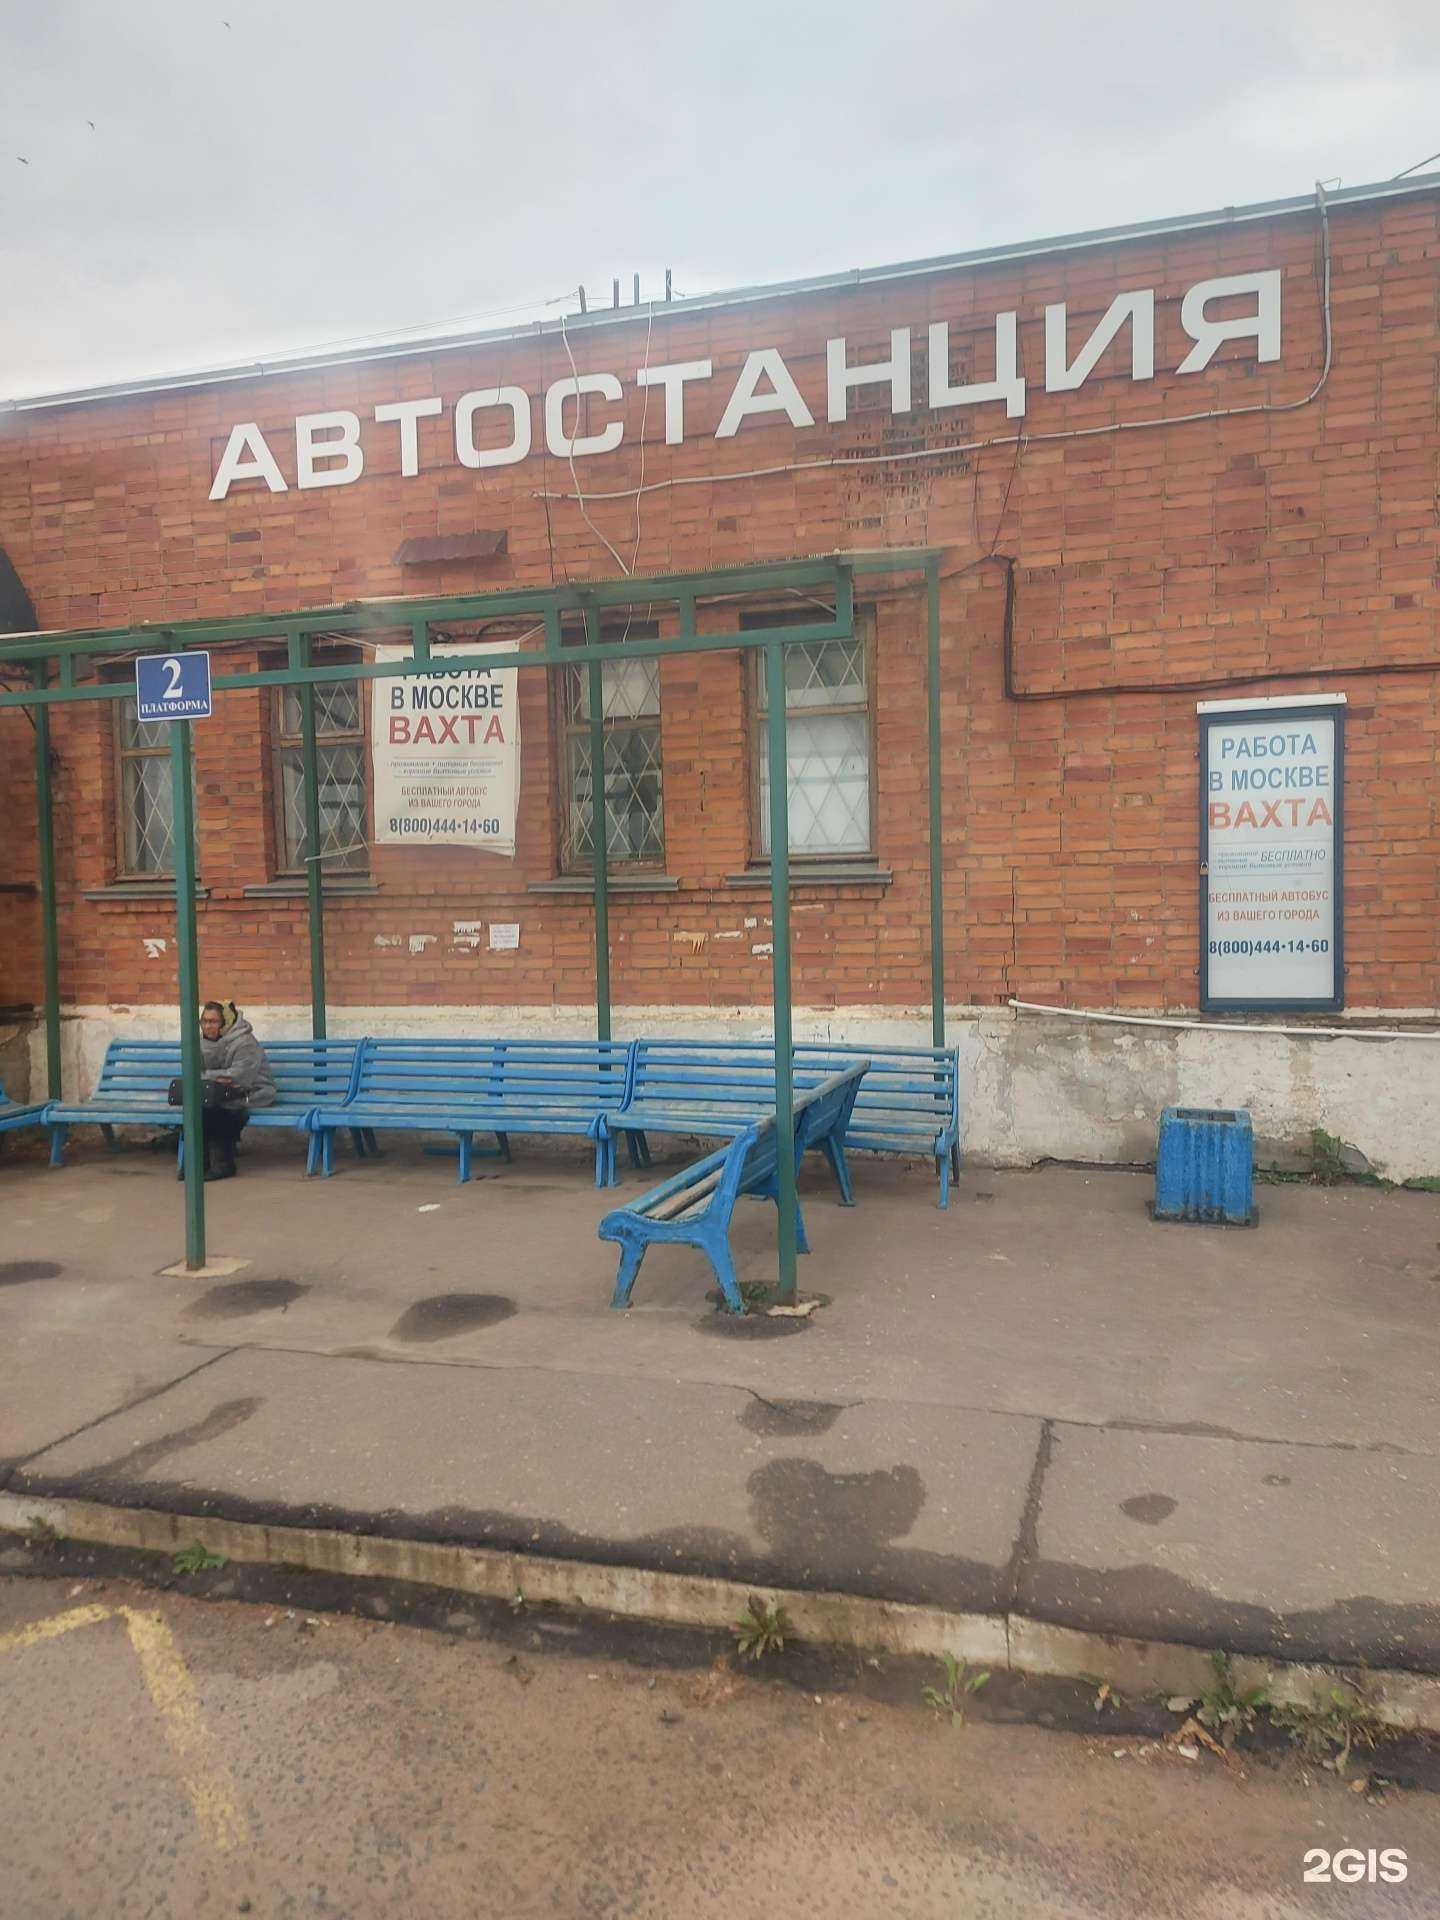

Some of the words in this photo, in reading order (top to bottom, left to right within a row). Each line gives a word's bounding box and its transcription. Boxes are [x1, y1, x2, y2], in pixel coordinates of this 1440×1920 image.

[208, 269, 1282, 500] АВТОСТАНЦИЯ
[161, 658, 184, 699] 2
[141, 699, 208, 714] ПЛАТФОРМА
[390, 686, 405, 710] В
[412, 684, 504, 710] МОСКВЕ
[389, 715, 505, 744] ВАХТА
[1220, 733, 1318, 759] РАБОТА
[401, 784, 455, 796] БЕСПЛАТНЫЙ
[456, 784, 488, 796] АВТОБУС
[1209, 771, 1224, 792] В
[1231, 765, 1330, 791] МОСКВЕ
[408, 798, 419, 808] ИЗ
[421, 798, 451, 808] ВАШЕГО
[453, 798, 481, 808] ГОРОДА
[1208, 798, 1333, 831] ВАХТА
[1260, 848, 1326, 863] БЕСПЛАТНО
[1208, 891, 1278, 903] БЕСПЛАТНЫЙ
[1280, 889, 1329, 902] АВТОБУС
[1217, 910, 1230, 921] ИЗ
[1233, 910, 1276, 921] ВАШЕГО
[1278, 909, 1320, 921] ГОРОДА
